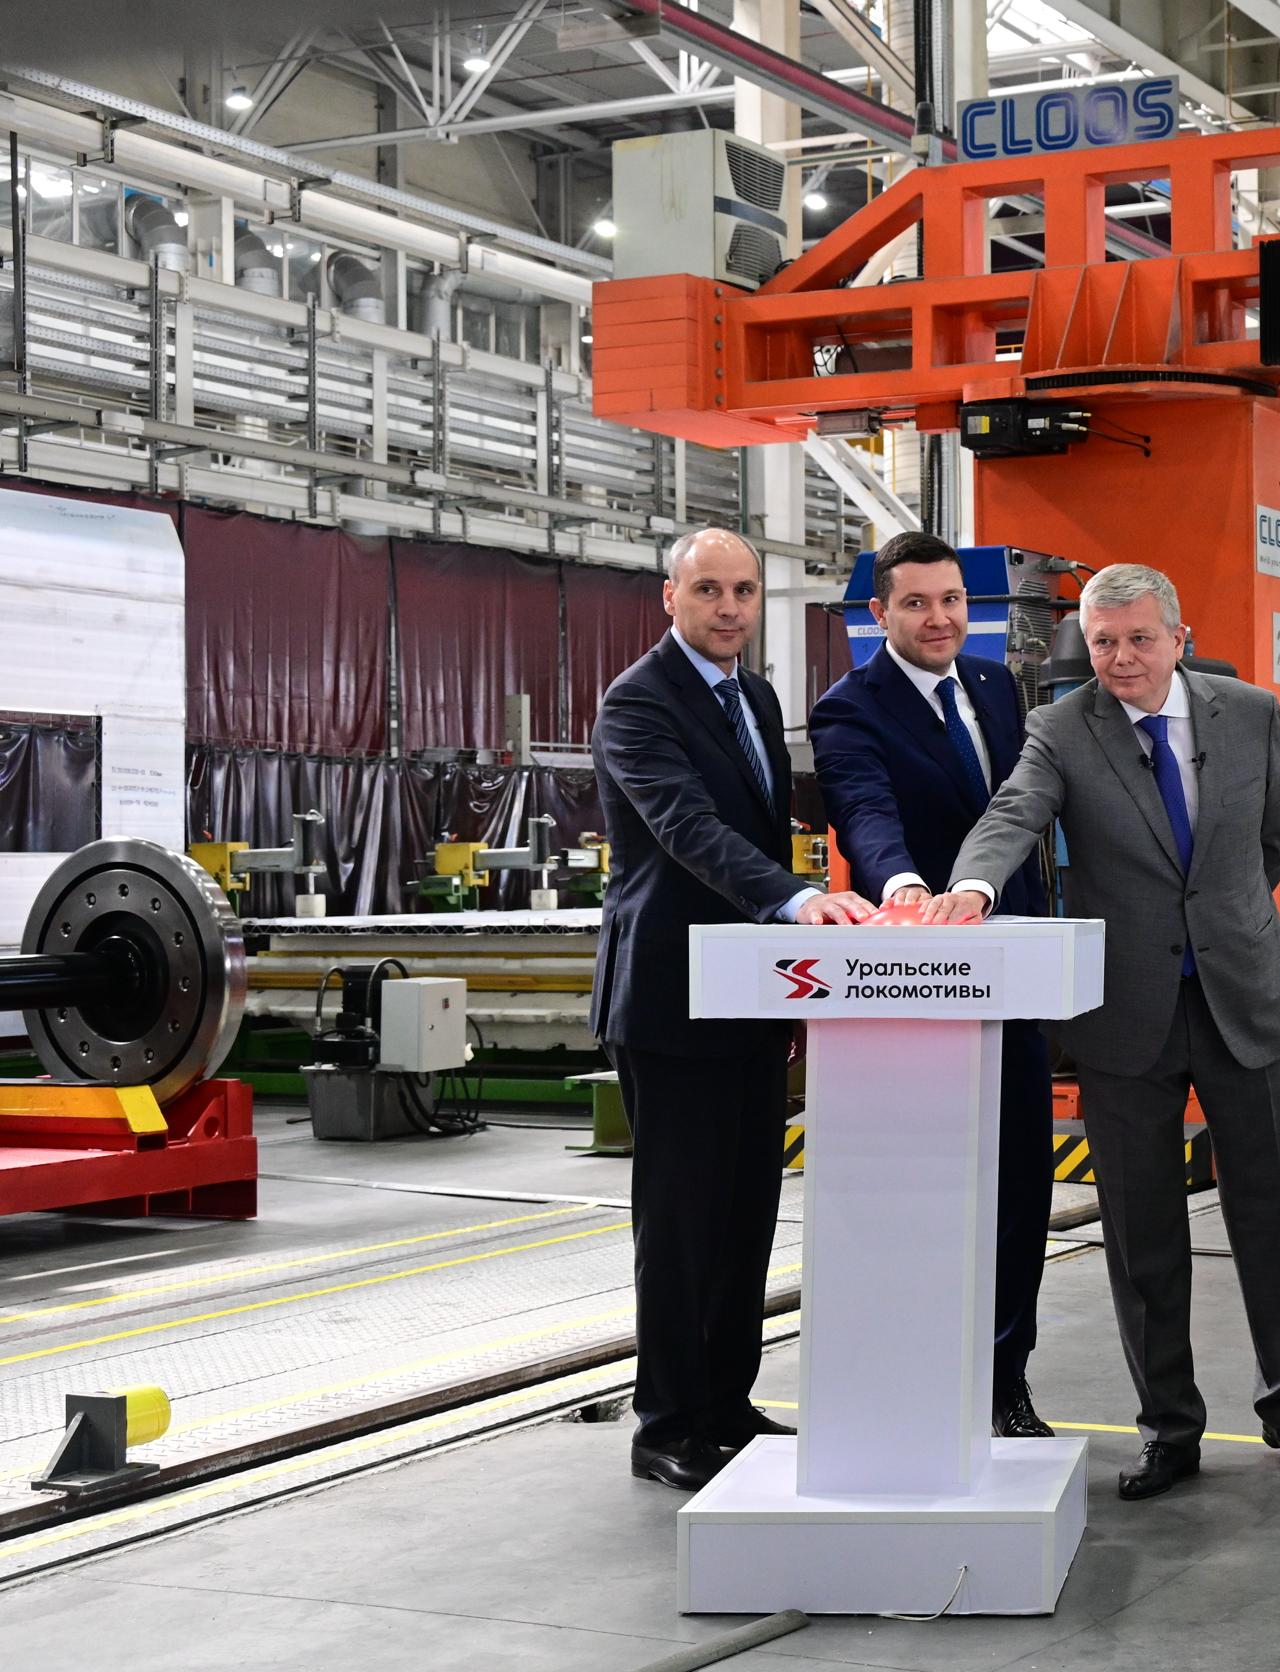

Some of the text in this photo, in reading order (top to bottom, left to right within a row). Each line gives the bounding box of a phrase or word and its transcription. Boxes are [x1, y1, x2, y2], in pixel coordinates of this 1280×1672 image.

[962, 80, 1173, 159] CLOOS
[858, 627, 884, 635] CLOOS
[845, 959, 971, 980] Уральские
[845, 985, 991, 998] локомотивы
